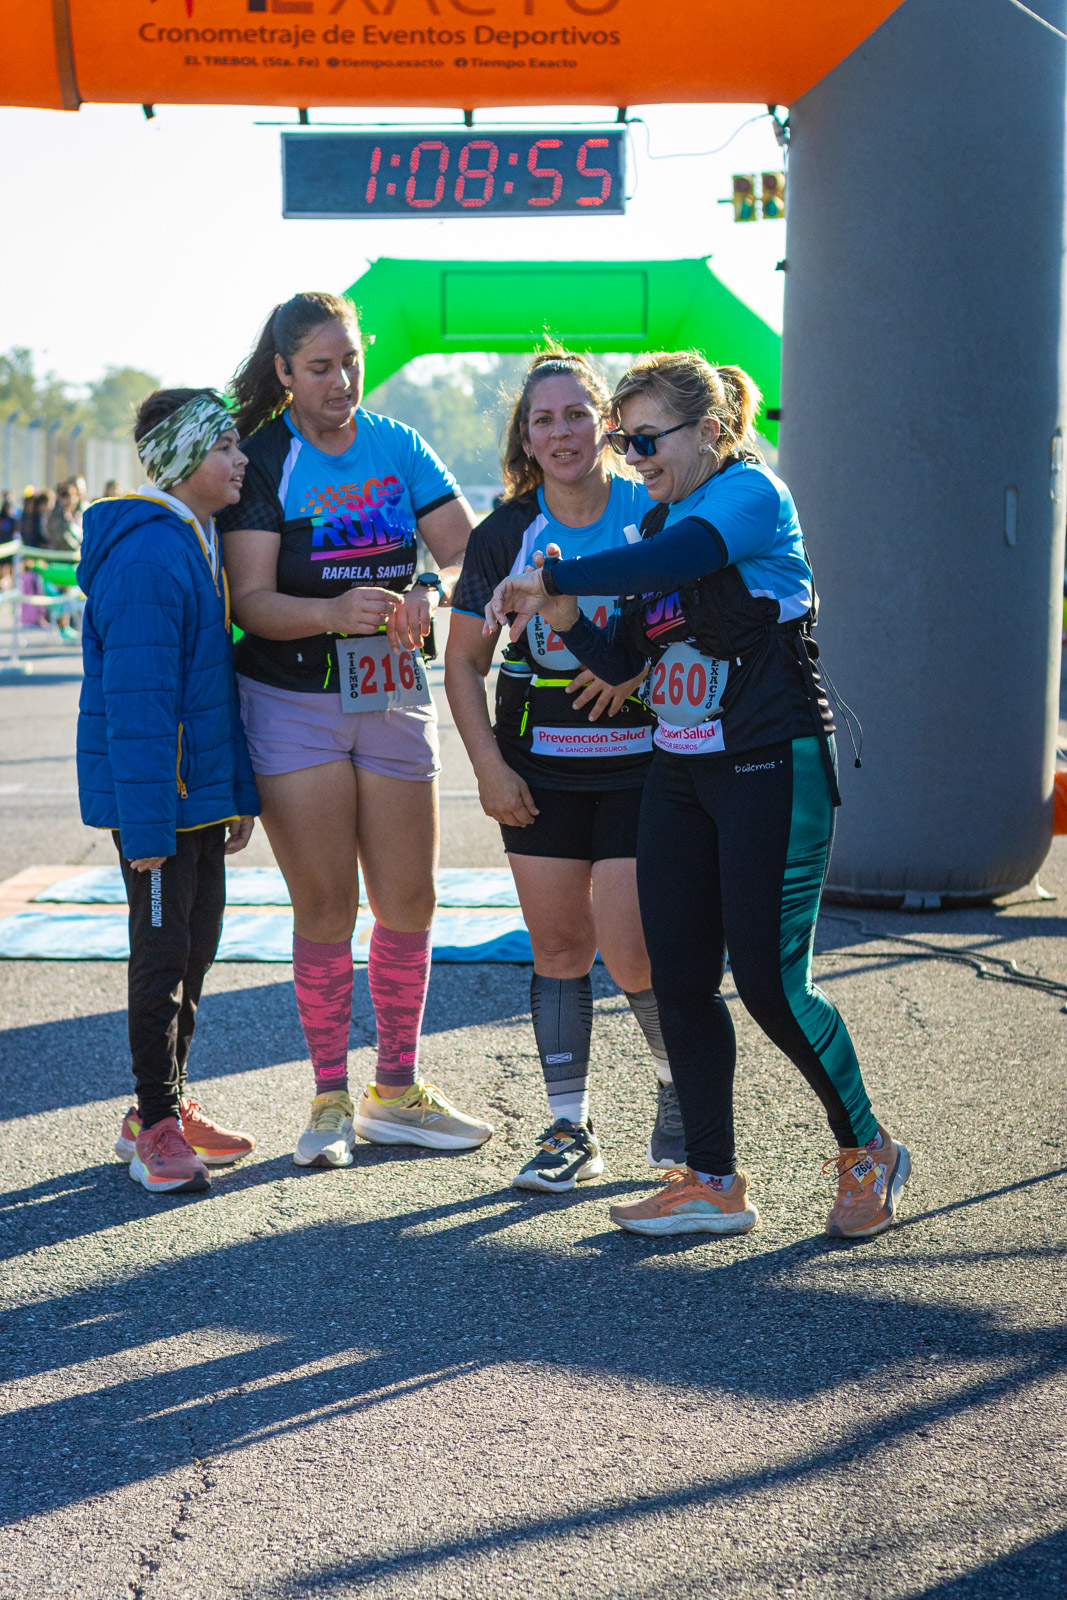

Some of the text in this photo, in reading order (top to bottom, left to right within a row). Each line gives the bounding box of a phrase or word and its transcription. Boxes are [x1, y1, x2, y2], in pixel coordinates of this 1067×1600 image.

[138, 22, 621, 48] Cronometraje de Eventos Deportivos
[185, 56, 201, 66] EL
[205, 55, 259, 66] TREBOL
[470, 58, 578, 69] Tiempo Exacto
[365, 138, 612, 208] 1:08:55
[321, 562, 414, 580] RAFAELA, SANTA FE
[347, 652, 359, 699] TIEMPO
[358, 651, 415, 695] 216
[652, 661, 707, 707] 260
[705, 660, 720, 710] EXACTO
[538, 731, 608, 743] Prevención
[610, 728, 646, 743] Salud
[683, 725, 715, 740] Salud
[595, 745, 627, 753] SEGUROS
[673, 742, 698, 750] SEGUROS
